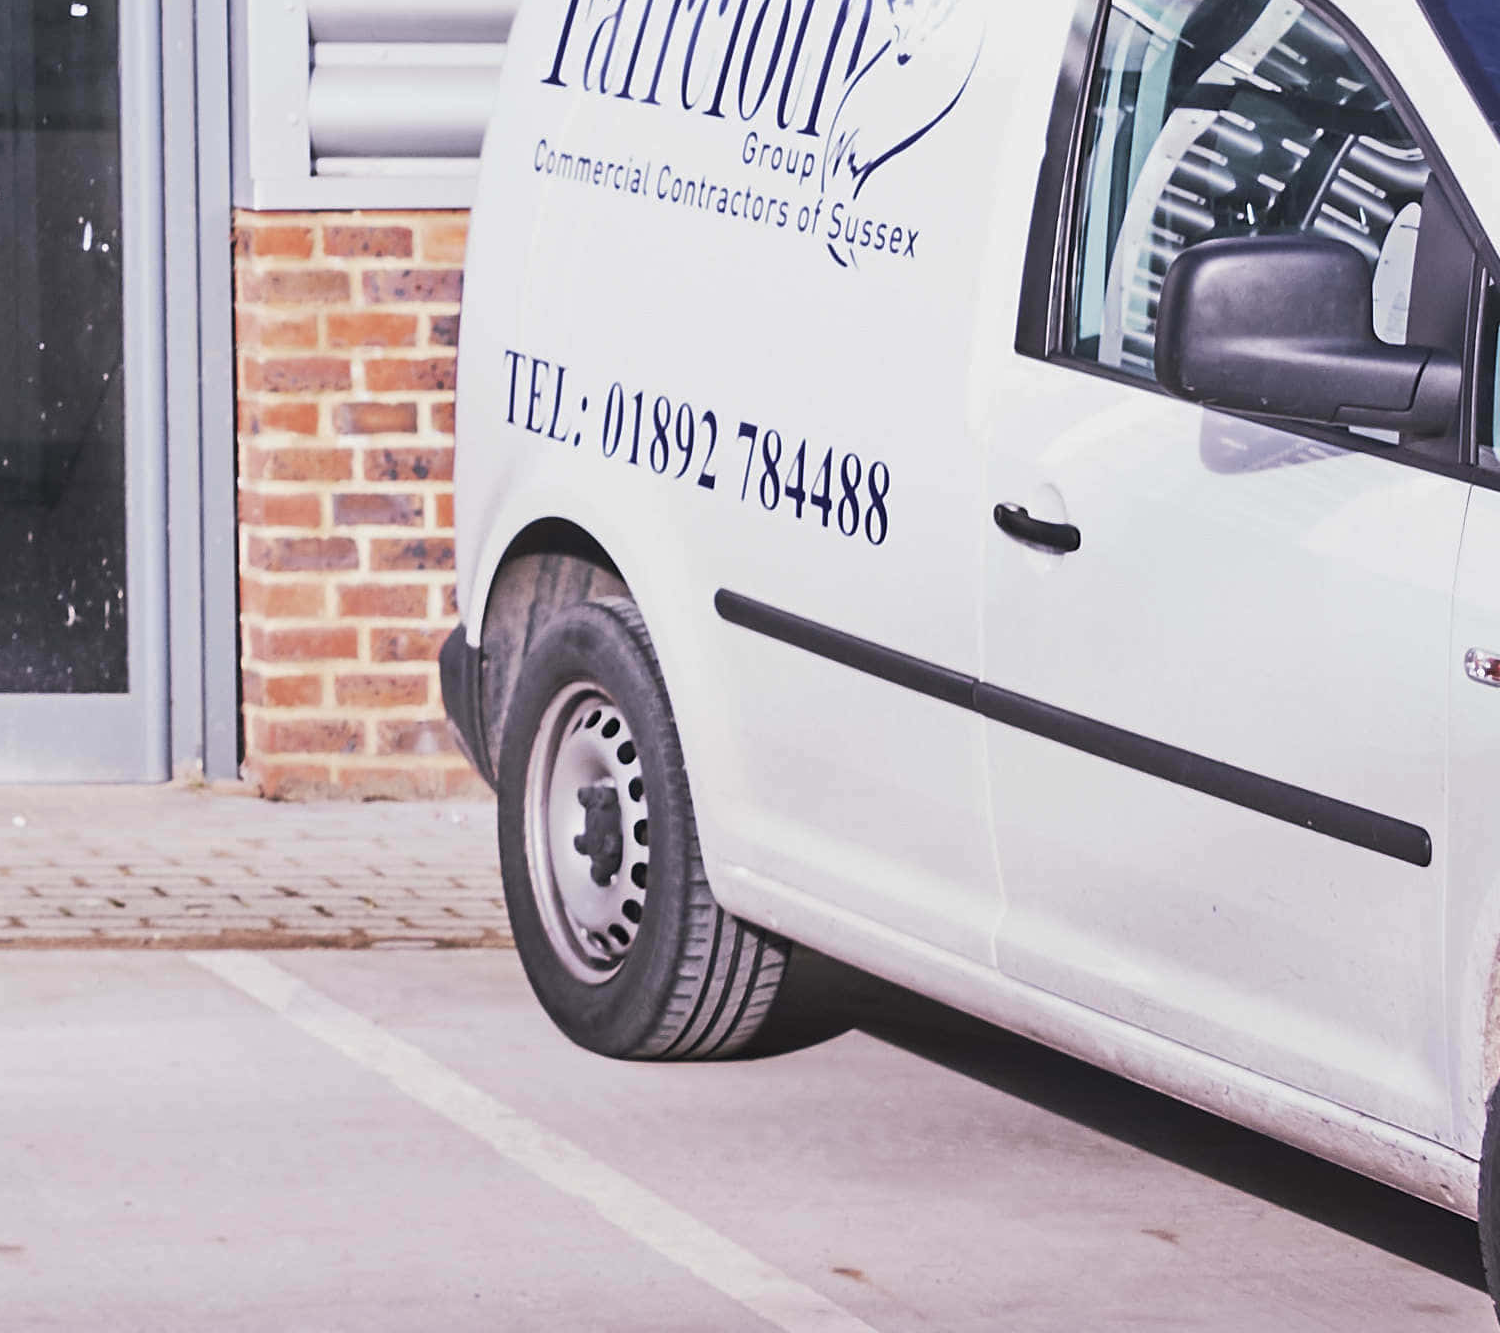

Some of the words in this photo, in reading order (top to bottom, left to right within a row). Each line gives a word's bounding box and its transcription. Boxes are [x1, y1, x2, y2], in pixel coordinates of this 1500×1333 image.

[533, 139, 649, 196] Commercial
[656, 165, 789, 228] Contractors
[797, 199, 823, 234] of
[827, 203, 920, 259] Sussex
[742, 131, 816, 185] Group
[504, 349, 588, 448] TEL:
[602, 382, 717, 490] 01892
[737, 421, 891, 546] 784488
